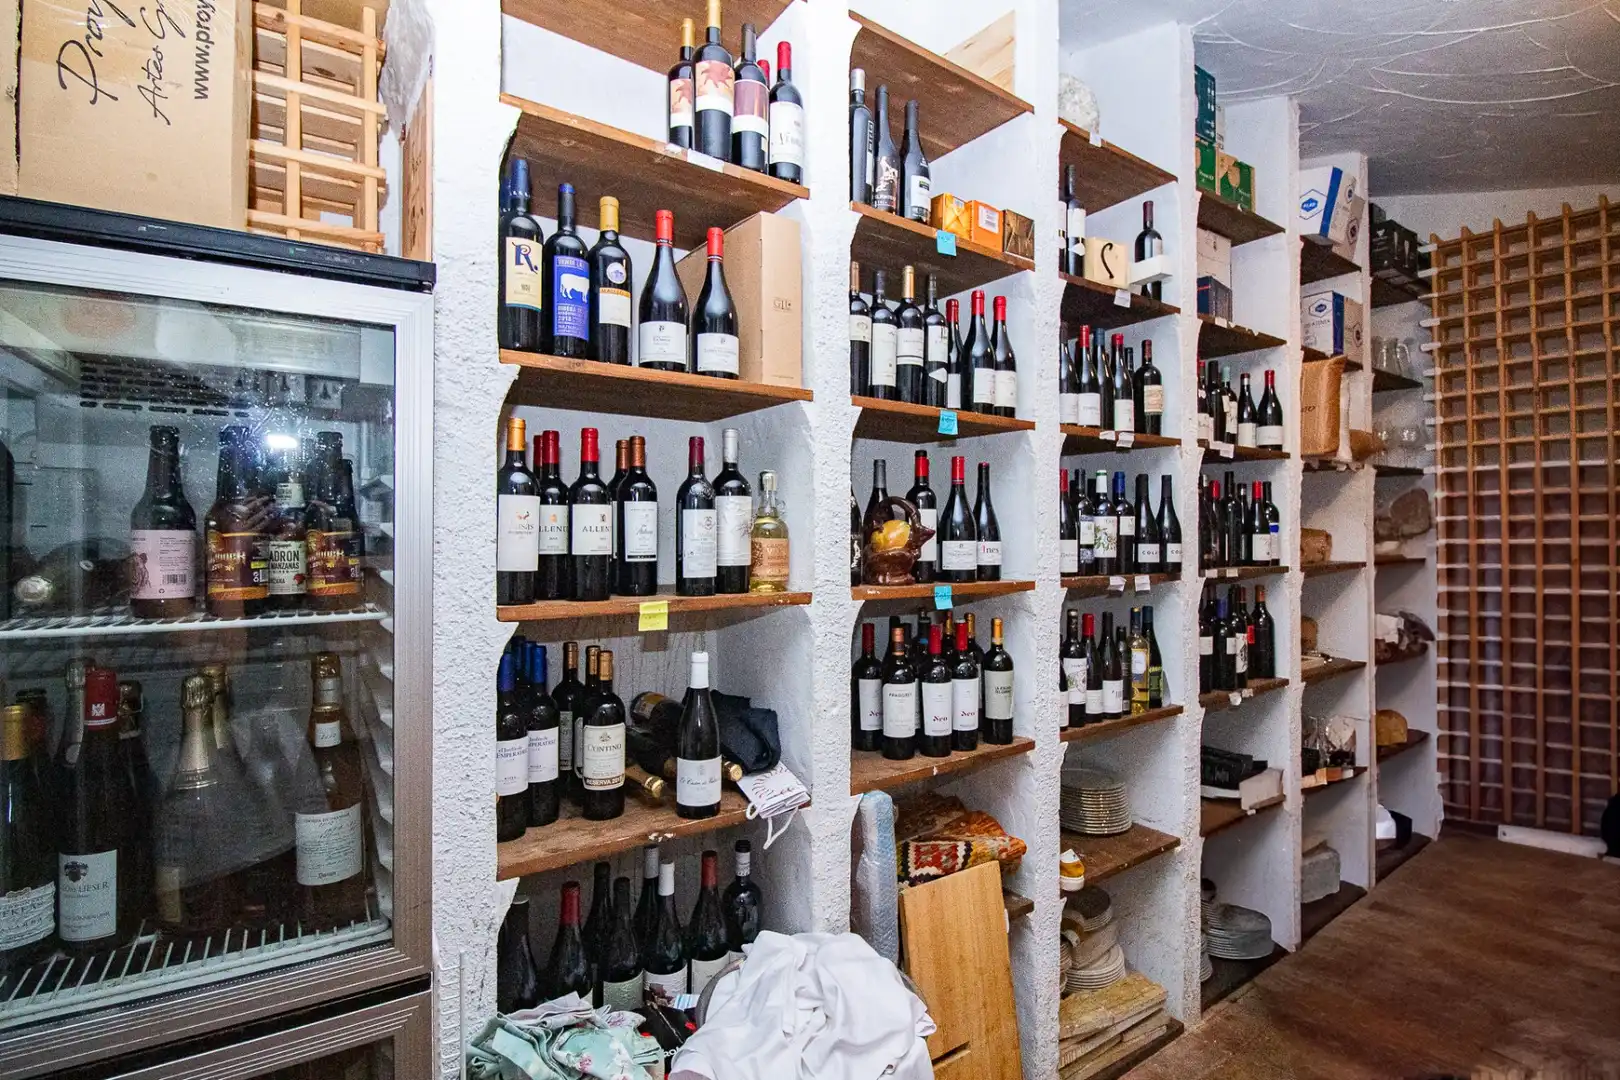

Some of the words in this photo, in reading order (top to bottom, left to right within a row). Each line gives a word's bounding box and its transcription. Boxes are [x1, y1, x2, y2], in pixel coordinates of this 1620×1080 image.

[269, 550, 300, 562] ADRON
[933, 714, 948, 722] Neo
[586, 777, 611, 787] RESERVA
